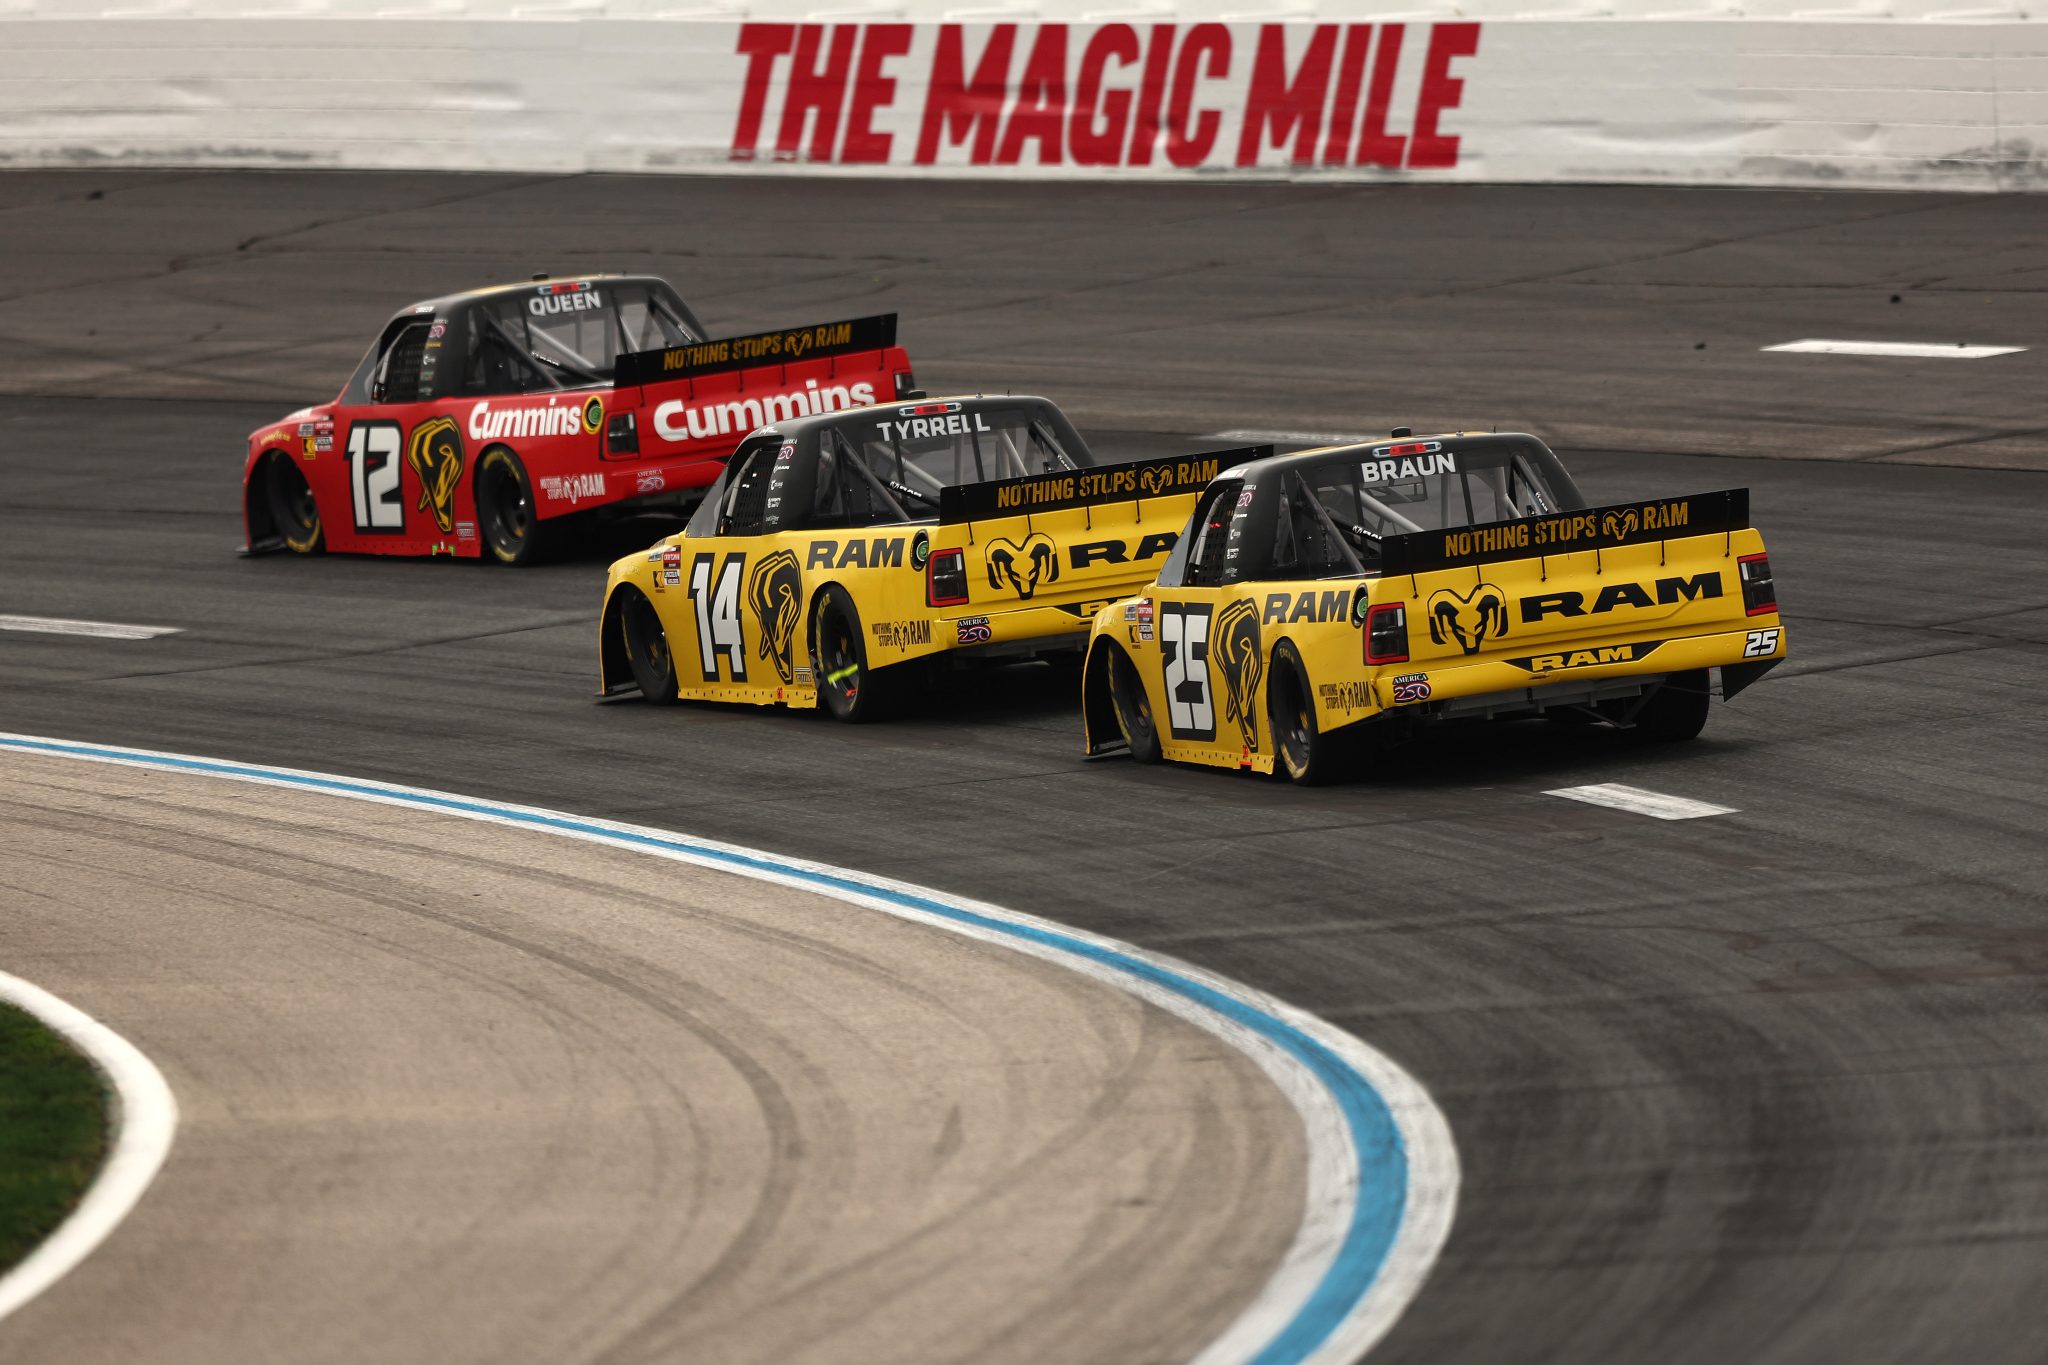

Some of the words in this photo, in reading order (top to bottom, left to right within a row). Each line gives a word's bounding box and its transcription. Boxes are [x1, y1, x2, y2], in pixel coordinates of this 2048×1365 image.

[729, 23, 914, 162] THE
[914, 23, 1233, 166] MAGIC
[1235, 23, 1481, 168] MILE
[529, 292, 602, 316] QUEEN
[664, 343, 728, 370] NOTHING
[732, 335, 781, 360] STOPS
[816, 324, 850, 347] RAM
[468, 398, 581, 439] Cummins
[653, 379, 876, 441] Cummins
[876, 413, 991, 442] TYRRELL
[347, 425, 403, 527] 12
[1360, 453, 1456, 482] BRAUN
[580, 474, 606, 497] RAM
[997, 478, 1074, 508] NOTHING
[1079, 470, 1136, 497] STOPS
[1178, 460, 1218, 485] RAM
[1445, 524, 1529, 557] NOTHING
[1535, 516, 1597, 545] STOPS
[1643, 502, 1688, 530] RAM
[806, 538, 905, 570] RAM
[1069, 532, 1180, 569] RA
[1262, 590, 1351, 625] RAM
[1519, 571, 1723, 623] RAM
[692, 562, 744, 673] 14
[872, 622, 891, 635] NOTHING
[958, 617, 989, 627] AMERICA
[879, 635, 893, 647] STOPS
[910, 620, 931, 645] RAM
[958, 625, 991, 644] 250
[1744, 629, 1779, 658] 25
[1162, 613, 1214, 731] 25
[1531, 646, 1633, 672] RAM
[1319, 683, 1338, 697] NOTHING
[1393, 673, 1428, 685] AMERICA
[1394, 682, 1431, 703] 250
[1326, 697, 1339, 709] STOPS
[1353, 681, 1372, 708] RAM
